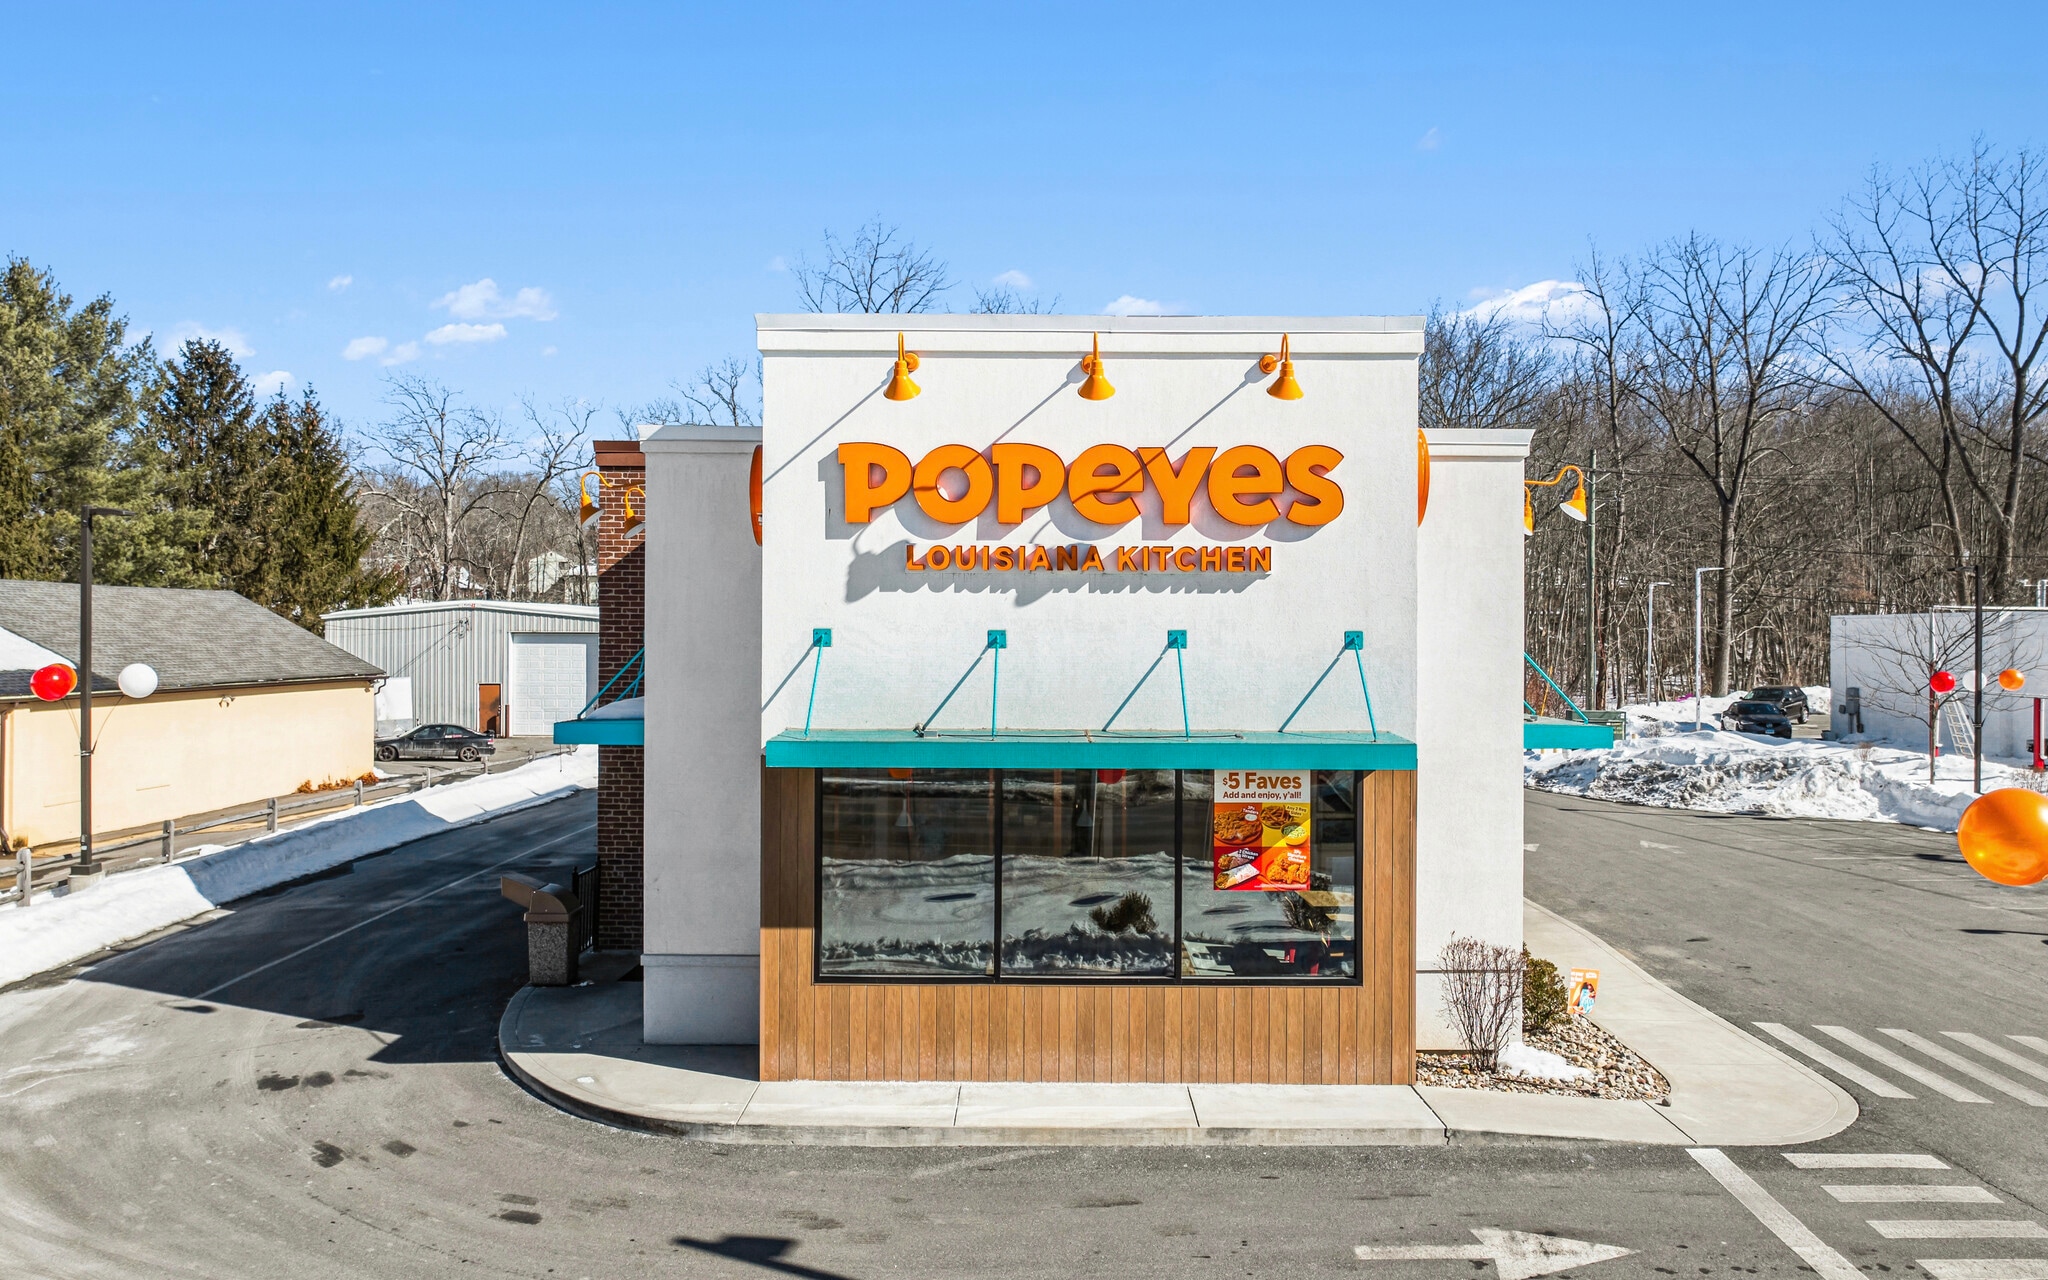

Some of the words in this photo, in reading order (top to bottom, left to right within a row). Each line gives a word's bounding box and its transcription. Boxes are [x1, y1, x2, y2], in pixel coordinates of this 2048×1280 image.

[906, 545, 1104, 571] LOUISIANA
[1117, 546, 1272, 572] KITCHEN
[1223, 772, 1240, 789] $5
[1245, 772, 1302, 789] Faves
[1258, 791, 1281, 800] enjoy,
[1283, 791, 1302, 800] y'all!
